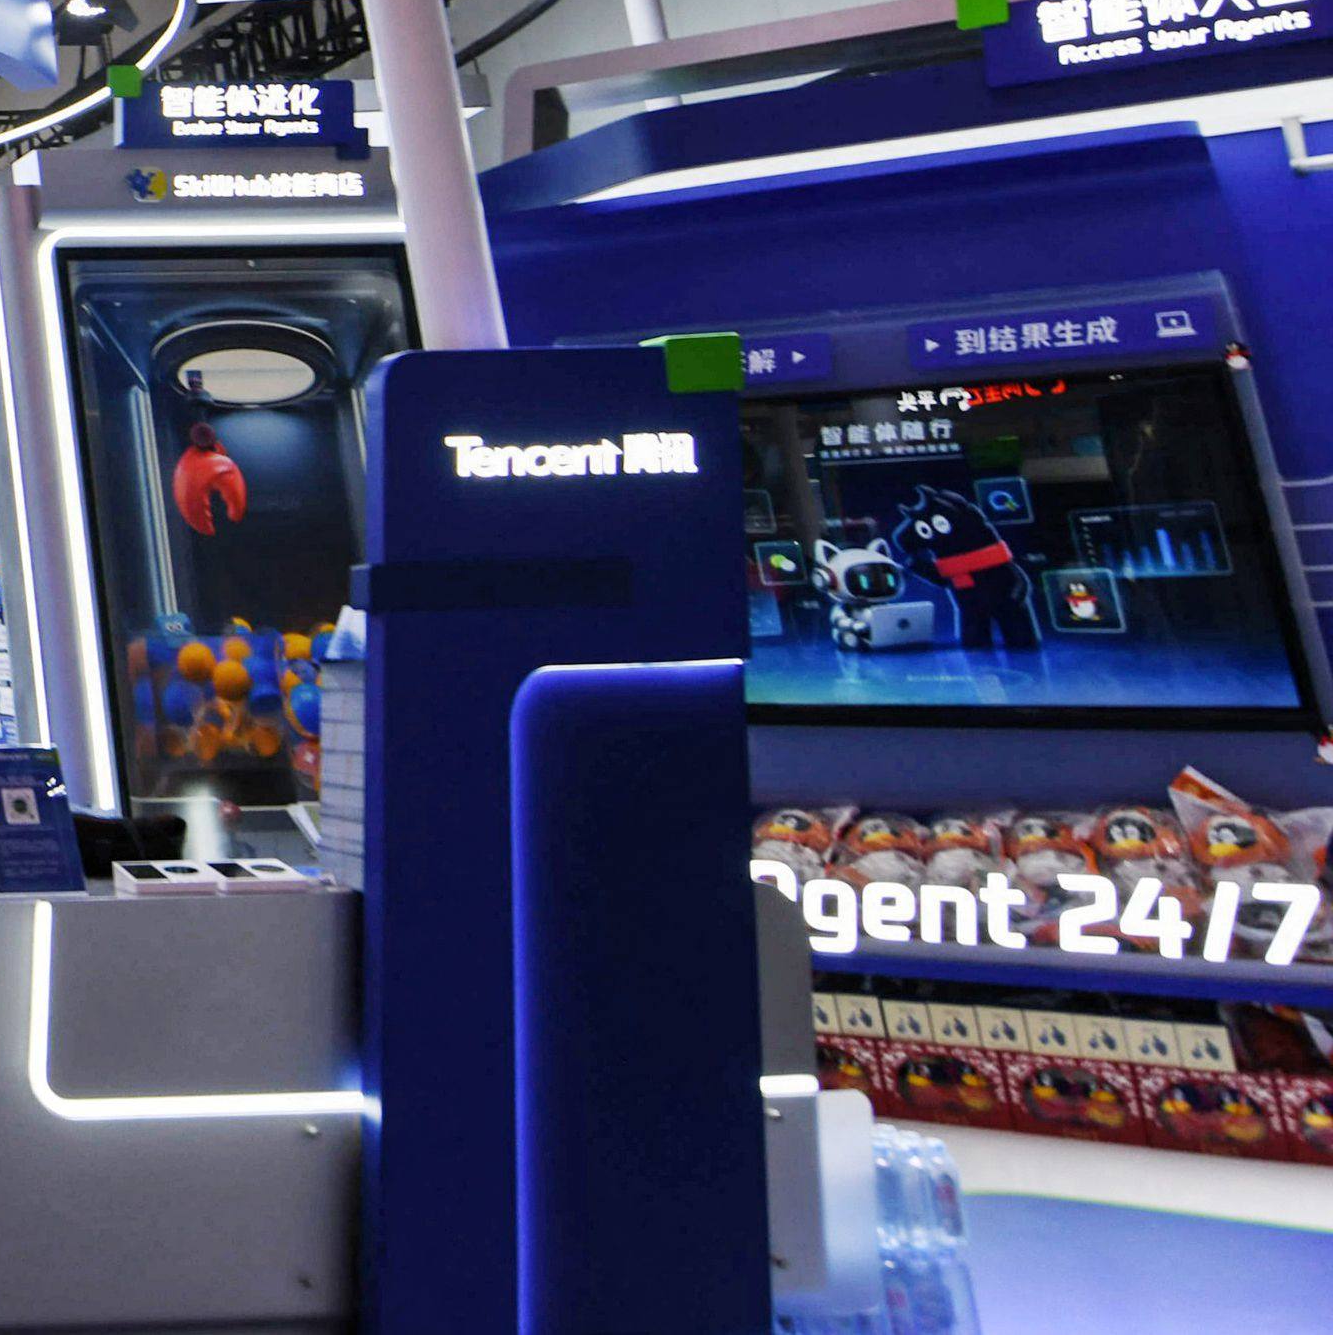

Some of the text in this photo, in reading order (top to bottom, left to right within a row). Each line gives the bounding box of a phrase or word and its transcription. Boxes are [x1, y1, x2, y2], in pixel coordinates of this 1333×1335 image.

[1058, 9, 1312, 65] Access Your Agents
[160, 84, 321, 117] 智能体进化
[954, 316, 1118, 356] 到结果生成
[443, 435, 624, 478] Tencent
[1055, 872, 1321, 966] 24/7
